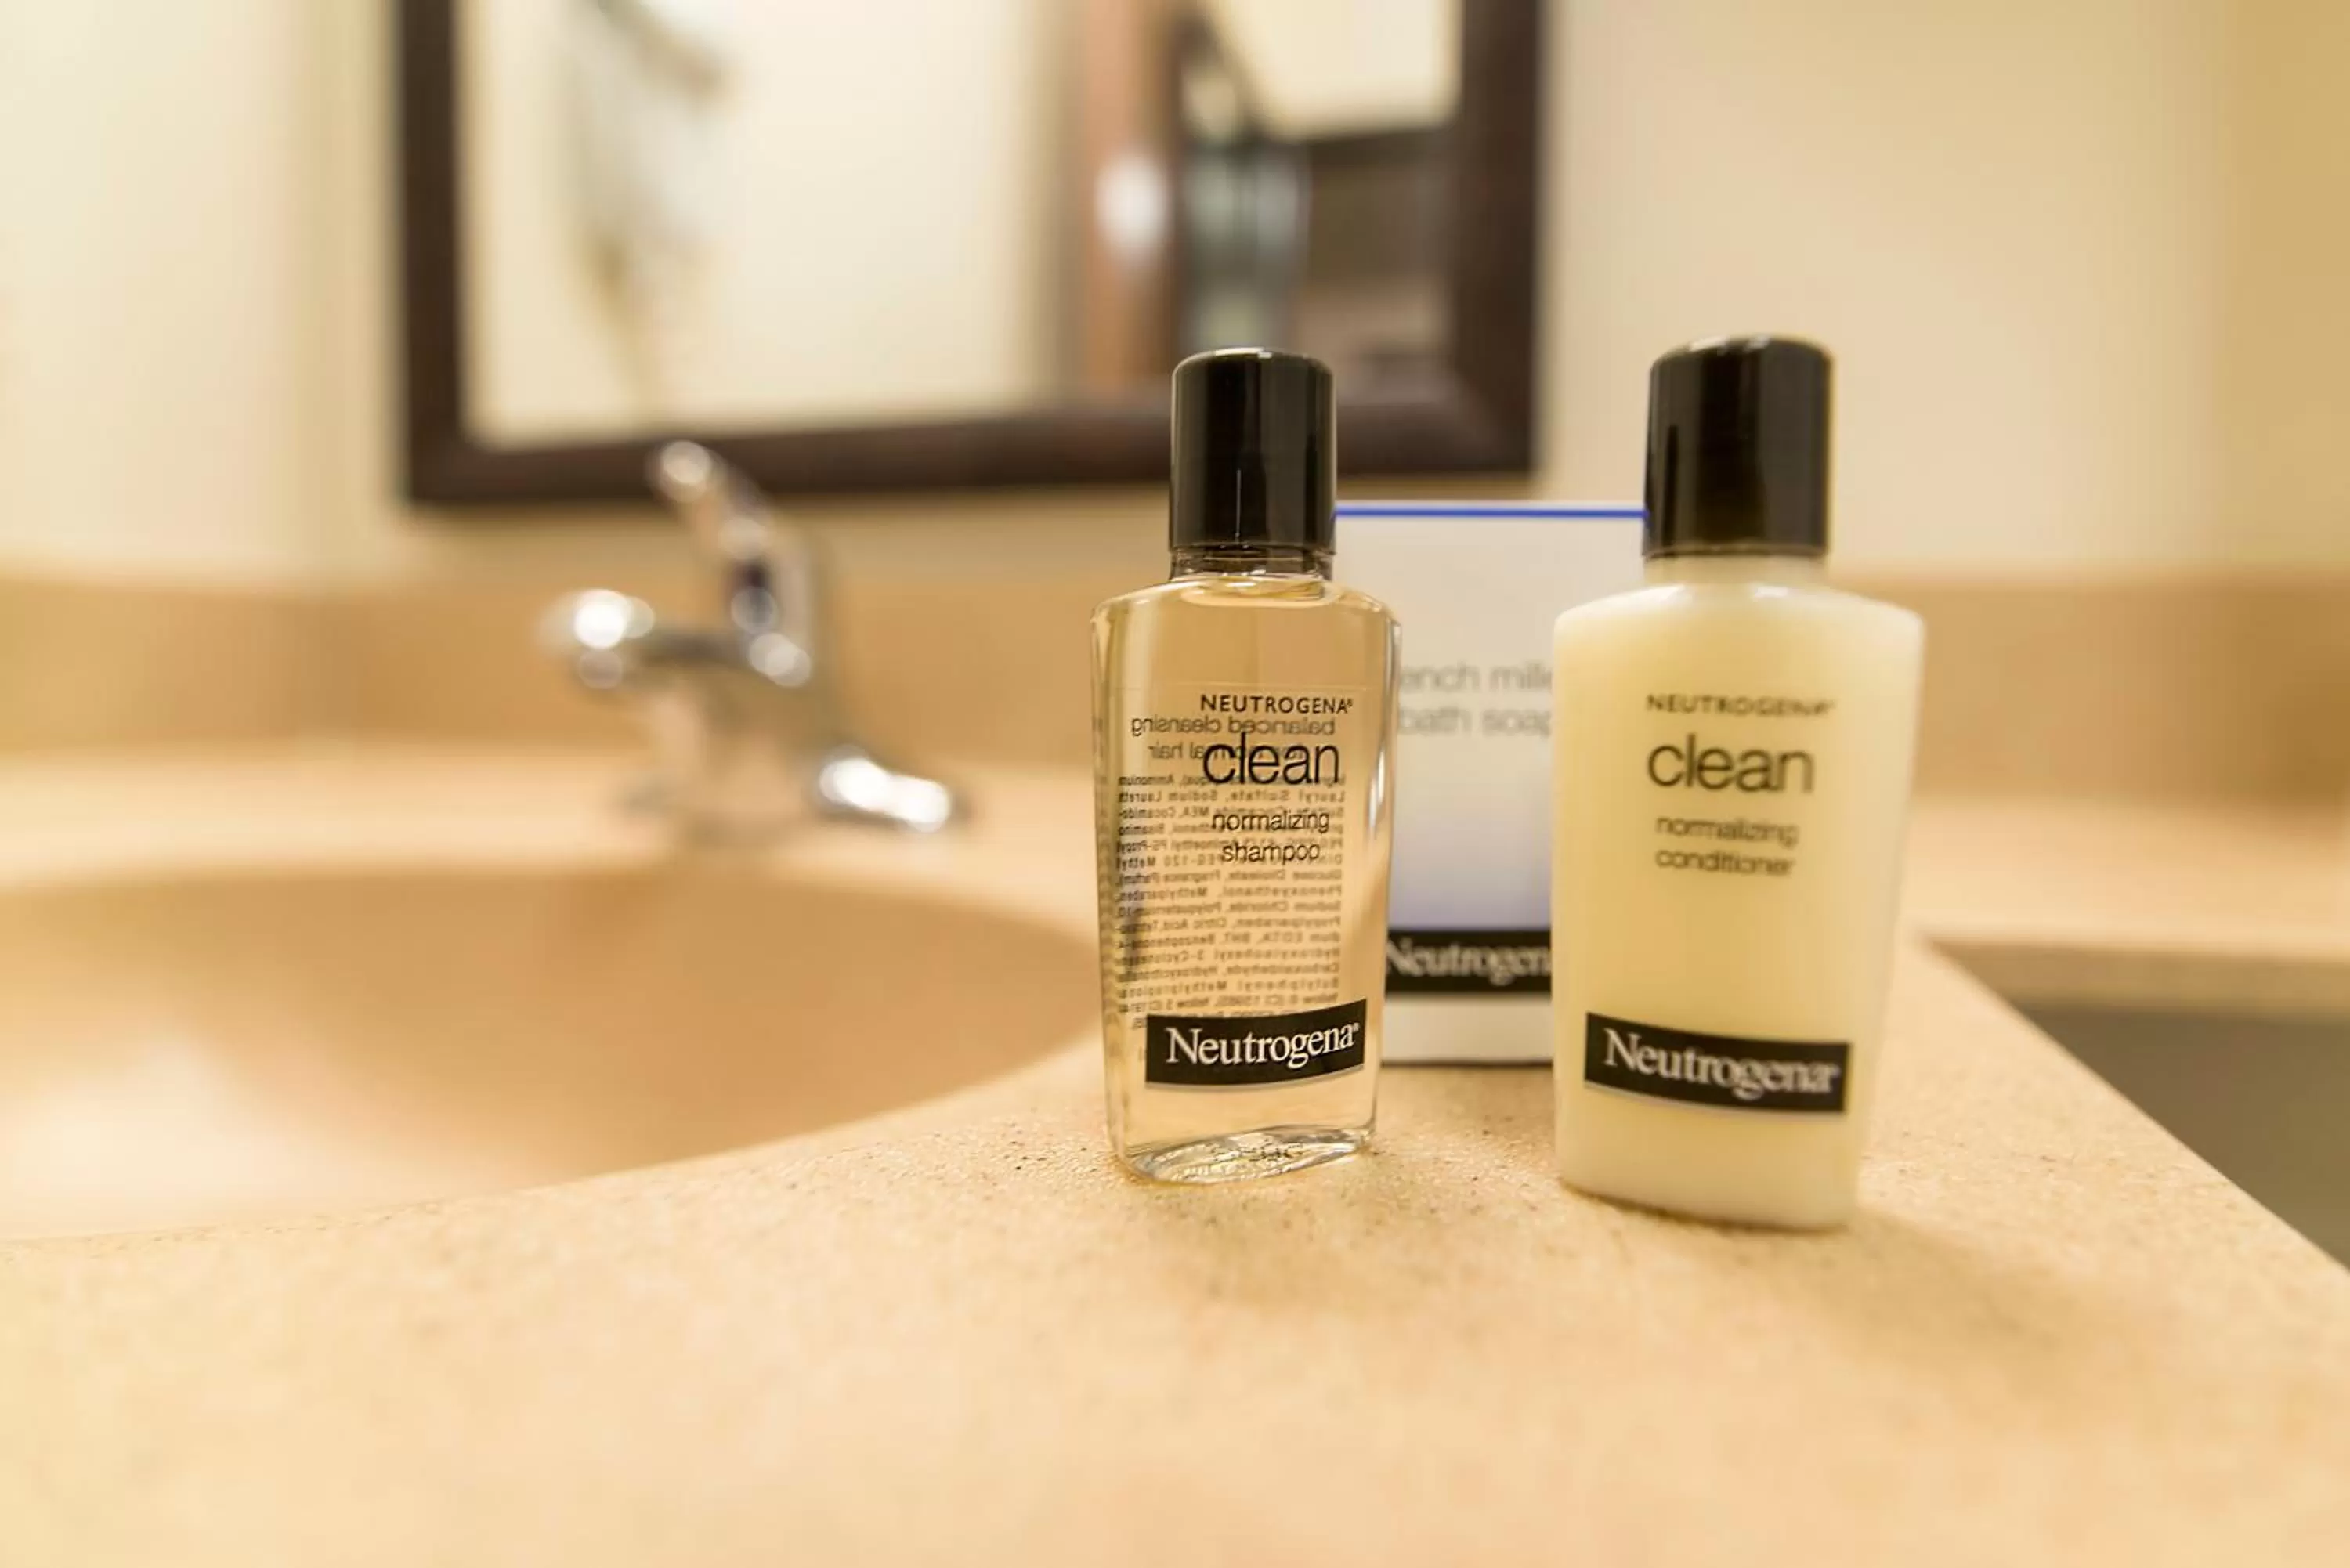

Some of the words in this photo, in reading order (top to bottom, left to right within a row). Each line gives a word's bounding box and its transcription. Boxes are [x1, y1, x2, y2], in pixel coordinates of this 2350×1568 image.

[1203, 731, 1340, 785] clean
[1647, 733, 1815, 794] clean
[1212, 810, 1329, 834] normalizing
[1657, 815, 1798, 848] normalizing
[1222, 842, 1320, 864] shampoo
[1656, 849, 1795, 878] conditioner
